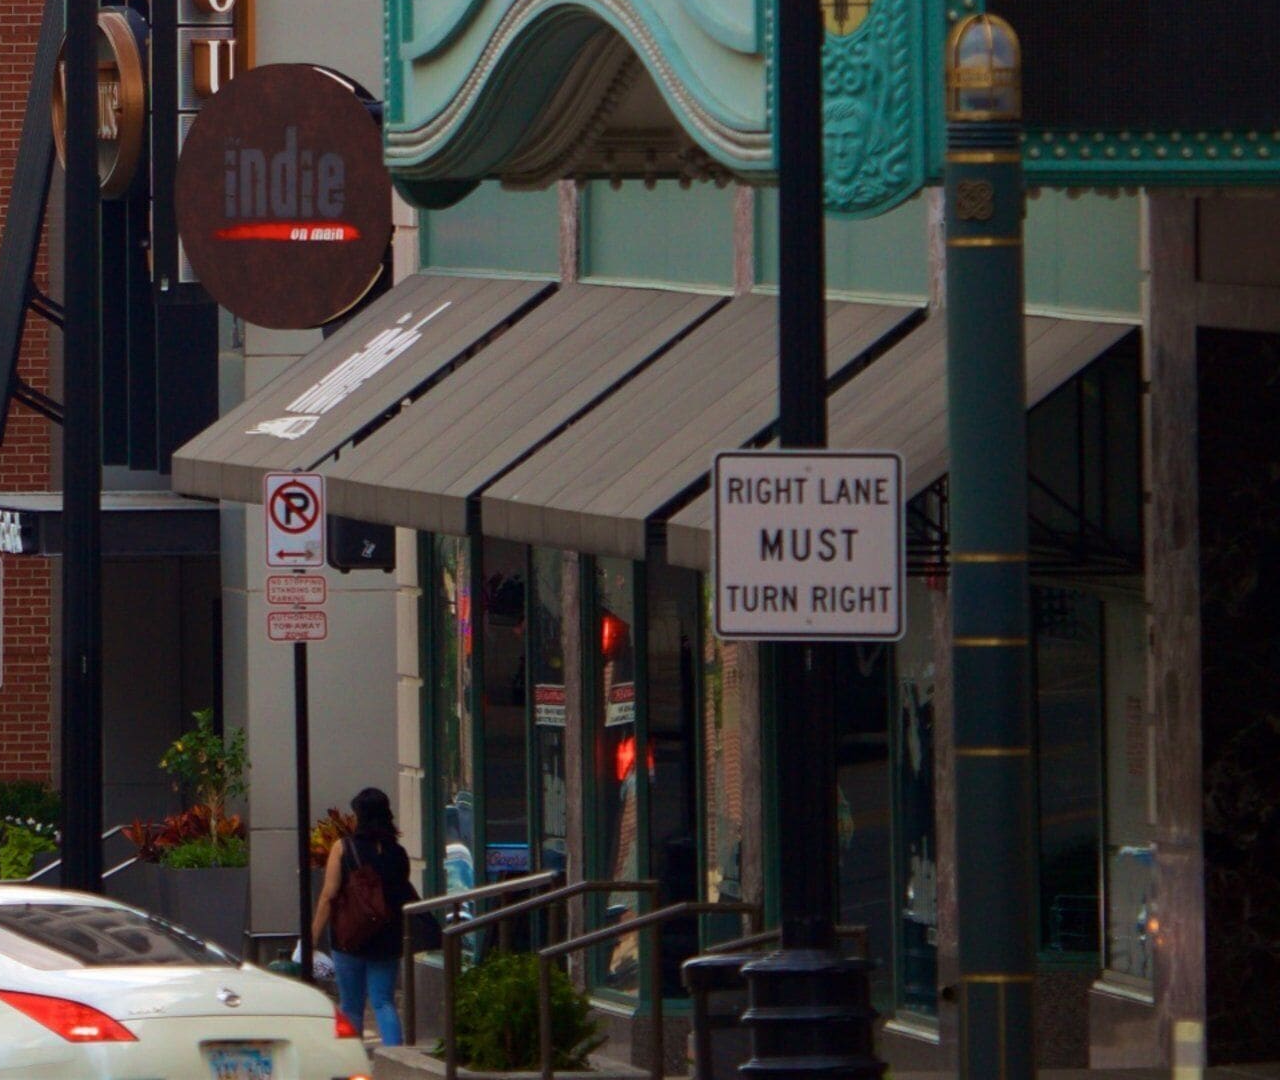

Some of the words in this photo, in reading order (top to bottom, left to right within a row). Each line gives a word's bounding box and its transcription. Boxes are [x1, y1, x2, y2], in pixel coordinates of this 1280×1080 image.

[225, 126, 345, 219] indie
[291, 228, 308, 241] on
[310, 228, 344, 241] main
[728, 478, 808, 505] RIGHT
[820, 478, 889, 505] LANE
[760, 529, 858, 562] MUST
[726, 585, 798, 613] TURN
[812, 586, 892, 613] RIGHT
